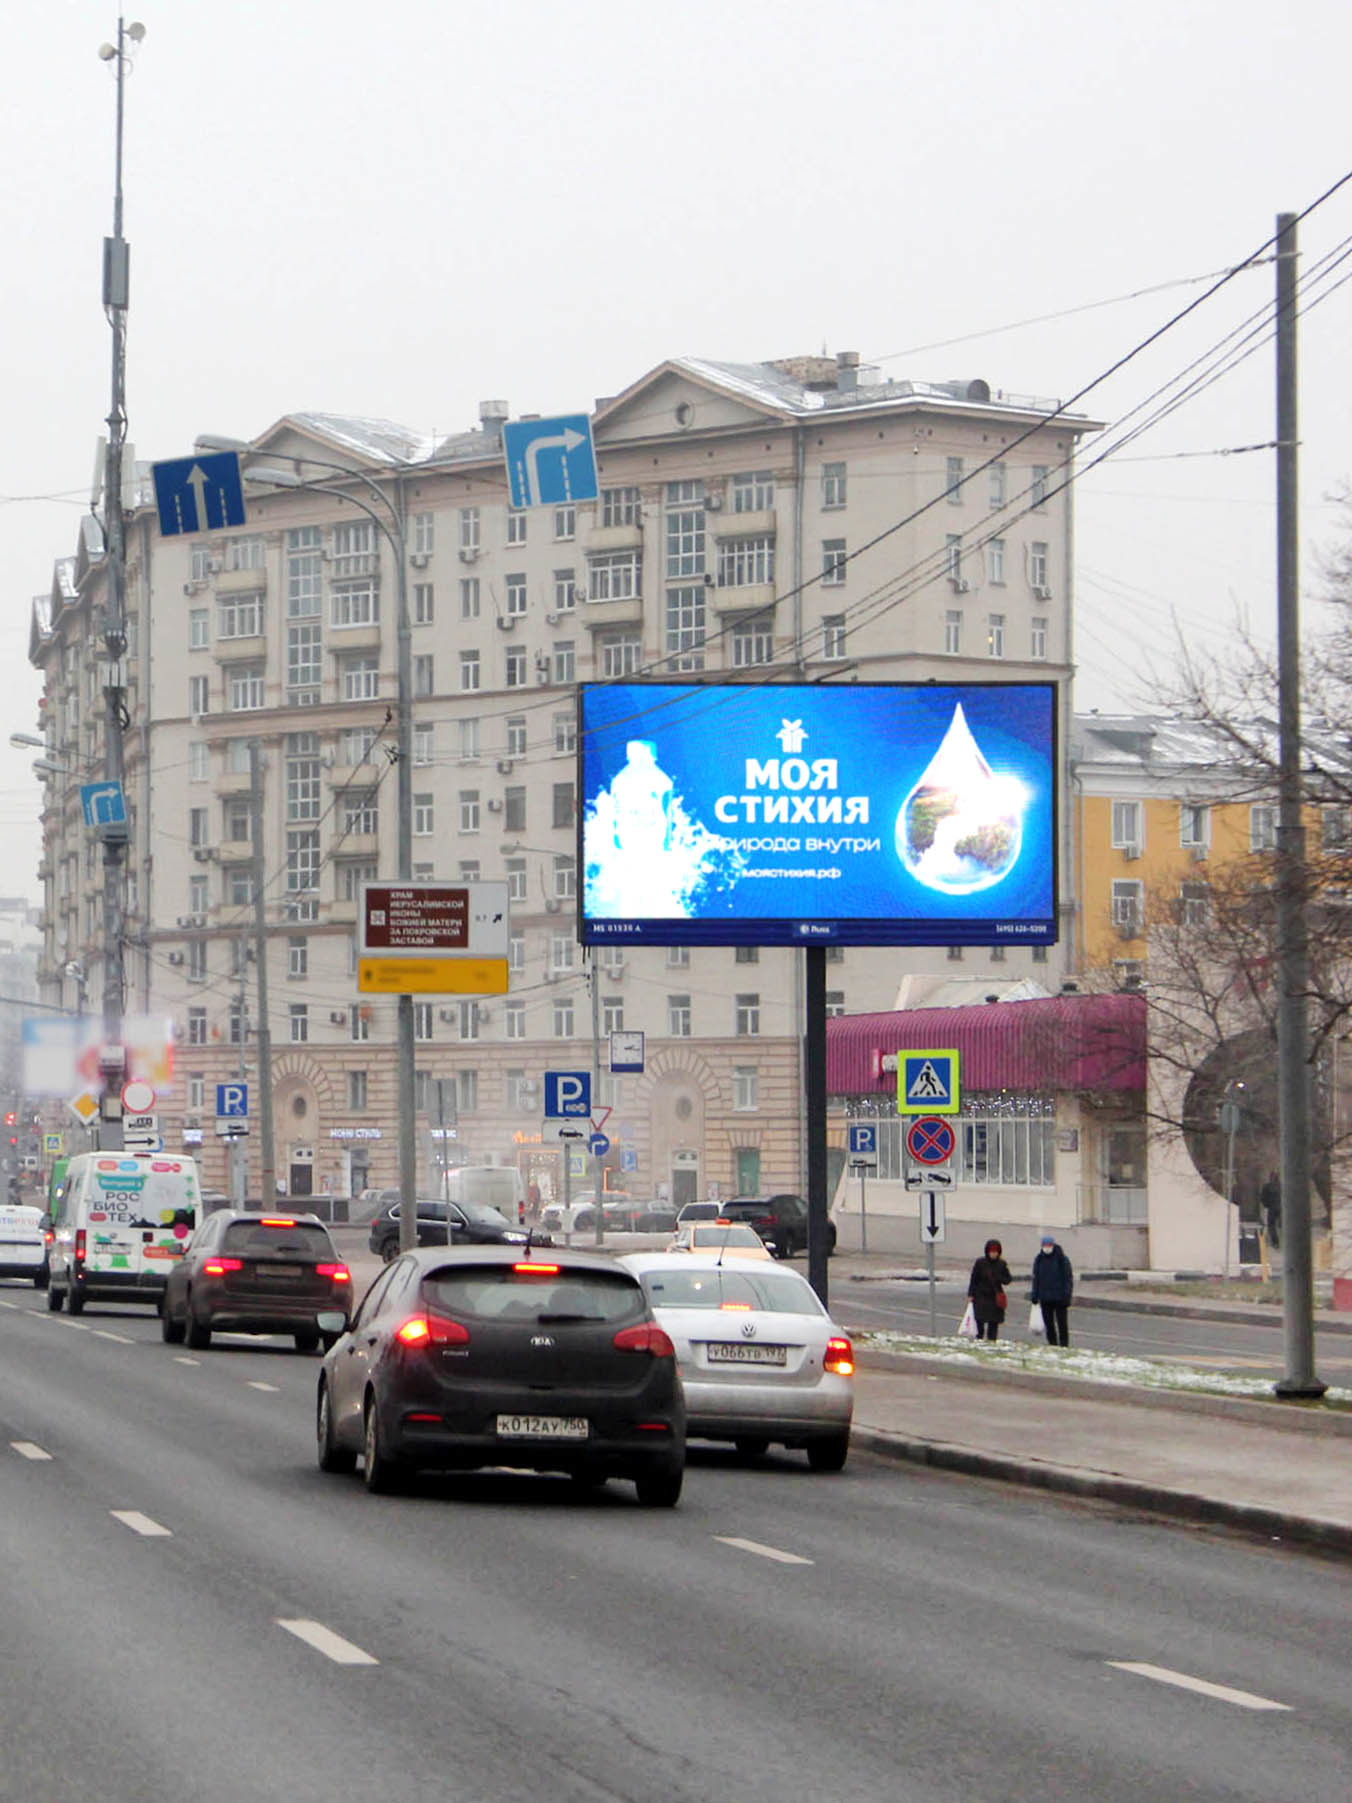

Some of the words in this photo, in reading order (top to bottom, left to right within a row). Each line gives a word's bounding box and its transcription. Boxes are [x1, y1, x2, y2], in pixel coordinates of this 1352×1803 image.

[745, 758, 838, 790] МОЯ
[714, 795, 870, 824] СТИХИЯ
[712, 837, 801, 853] рирода
[805, 837, 881, 854] внутри
[390, 891, 414, 899] ХРАМ
[390, 900, 465, 909] ИЕРУСАЛИМСКОЙ
[428, 919, 463, 927] МАТЕРИ
[390, 927, 401, 936] ЗА
[402, 927, 461, 936] ПОКРОВСКОЙ
[390, 936, 435, 945] ЗАСТАВОЙ
[105, 1192, 141, 1202] РОС
[93, 1202, 129, 1212] БИО
[108, 1213, 137, 1223] ТЕХ
